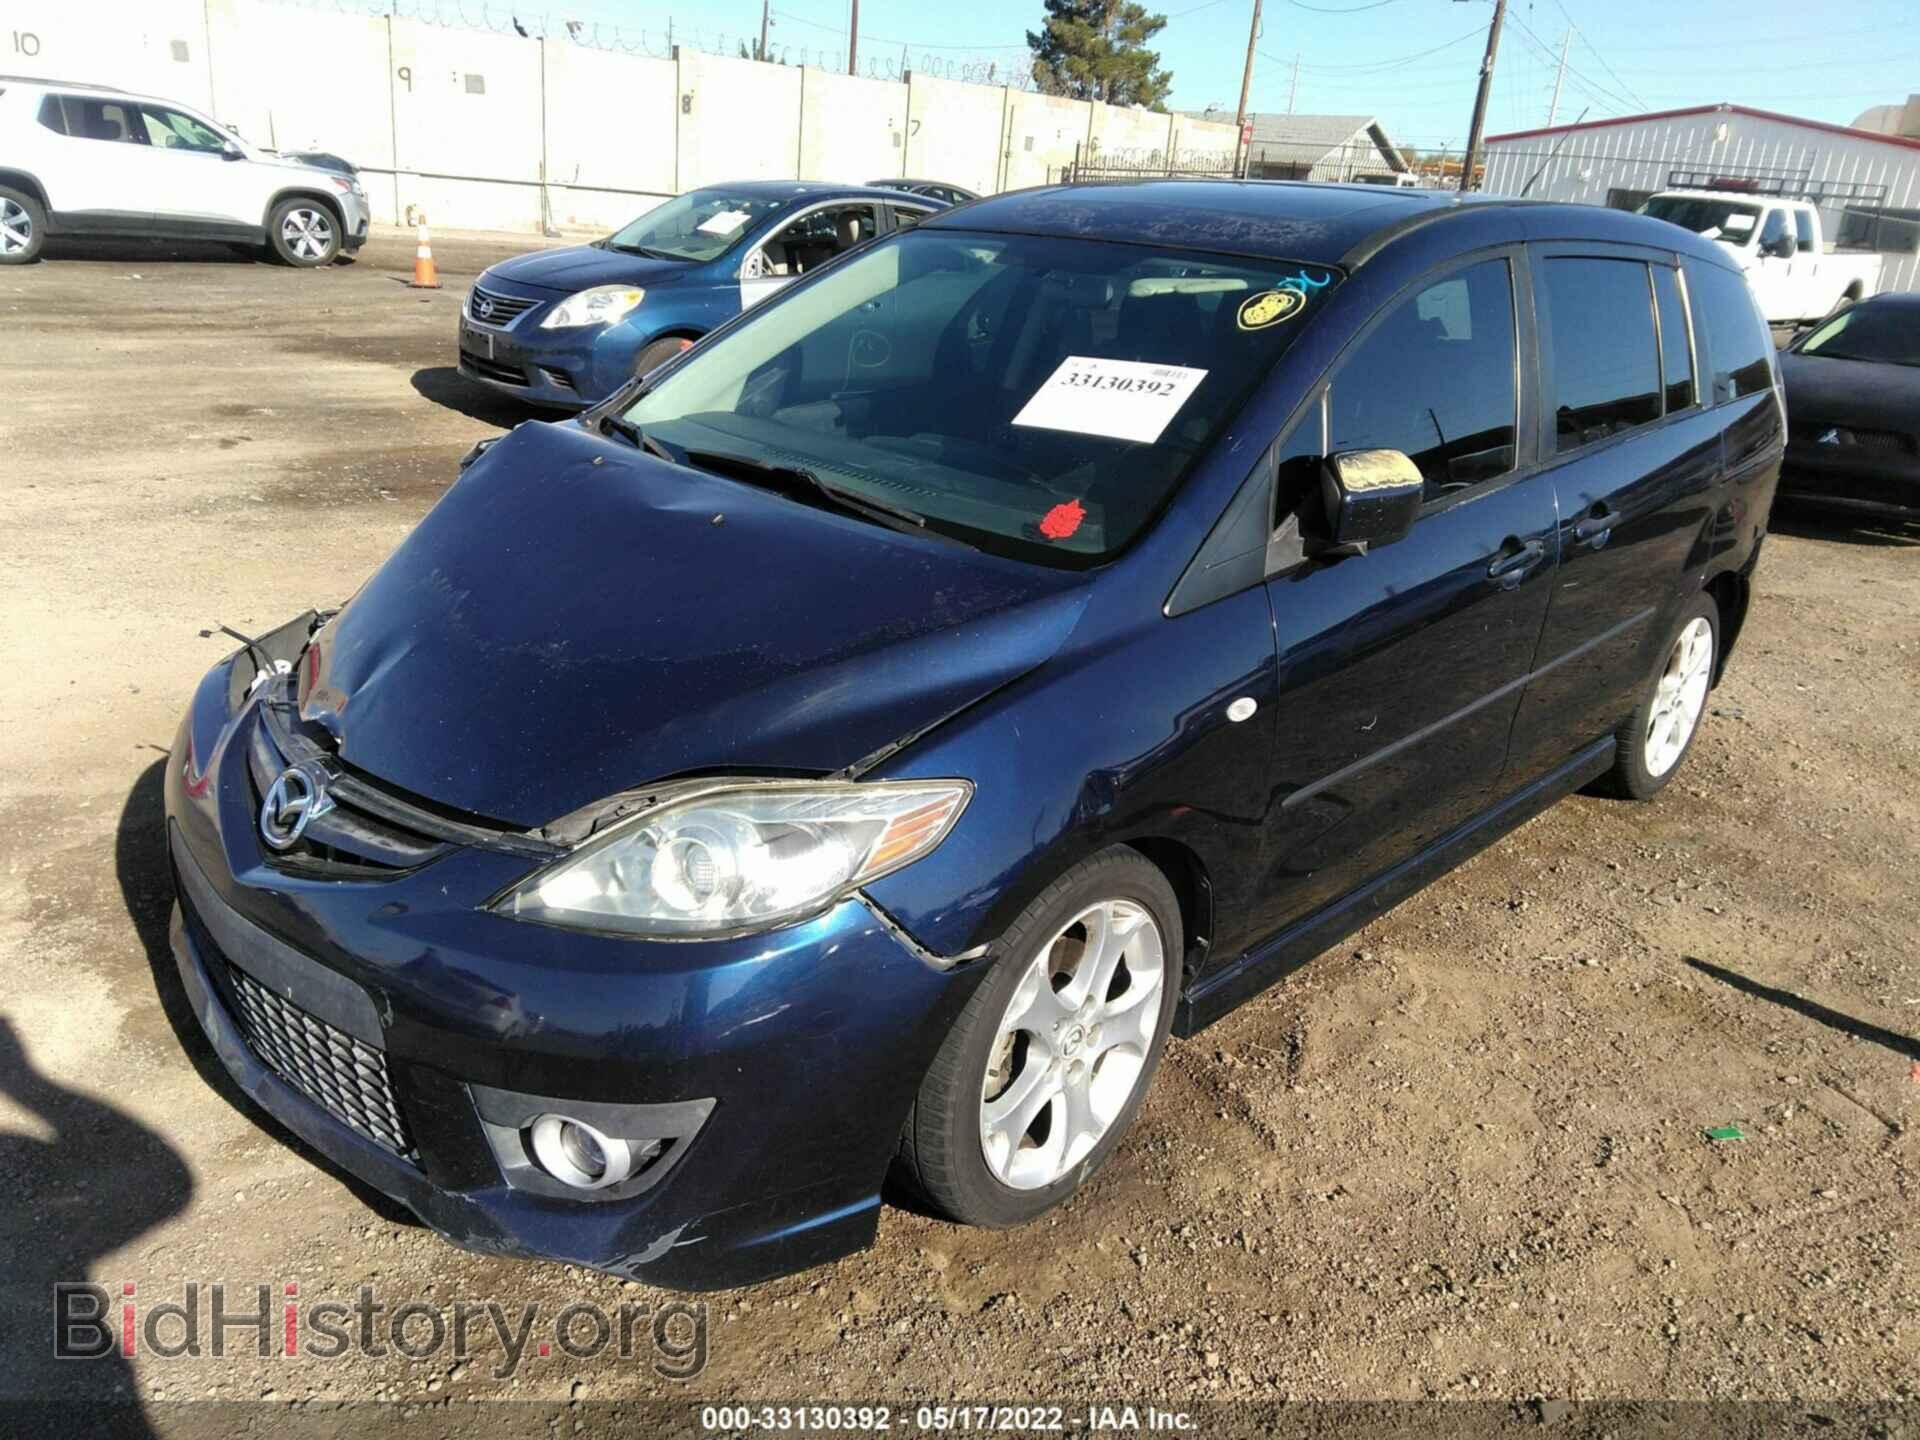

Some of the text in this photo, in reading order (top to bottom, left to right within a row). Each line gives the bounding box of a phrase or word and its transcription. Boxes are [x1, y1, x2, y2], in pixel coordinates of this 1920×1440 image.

[13, 30, 40, 56] 10
[398, 66, 411, 92] 9
[681, 94, 691, 114] 8
[911, 119, 921, 136] 7
[1060, 372, 1176, 397] 33130392
